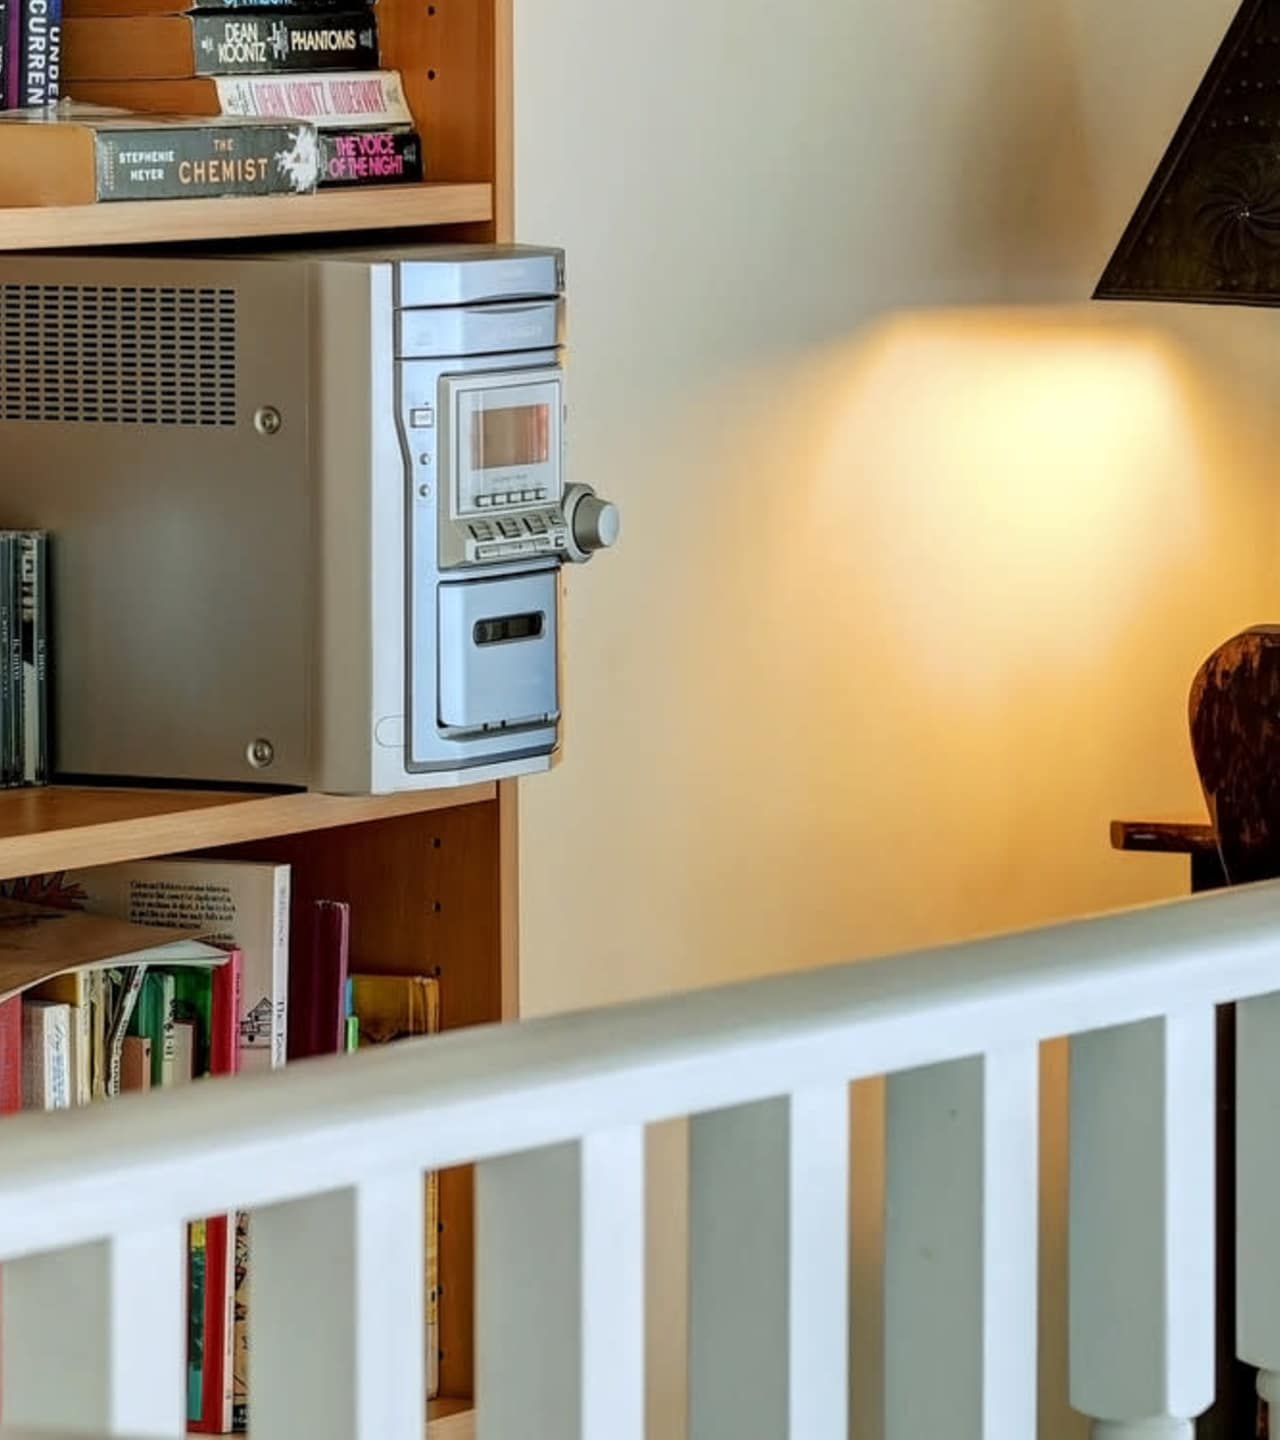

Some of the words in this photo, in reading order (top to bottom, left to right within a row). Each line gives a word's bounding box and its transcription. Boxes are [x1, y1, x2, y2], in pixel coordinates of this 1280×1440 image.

[223, 22, 259, 43] DEAN
[290, 29, 358, 51] PHANTOMS
[218, 43, 267, 63] KOONTZ
[213, 138, 235, 152] THE
[335, 135, 359, 157] THE
[359, 134, 396, 155] VOICE
[119, 149, 176, 164] STEPHENIE
[328, 159, 348, 177] OF
[347, 157, 369, 178] THE
[368, 155, 405, 176] NIGHT
[129, 167, 165, 182] MEYER
[177, 158, 270, 185] CHEMIST
